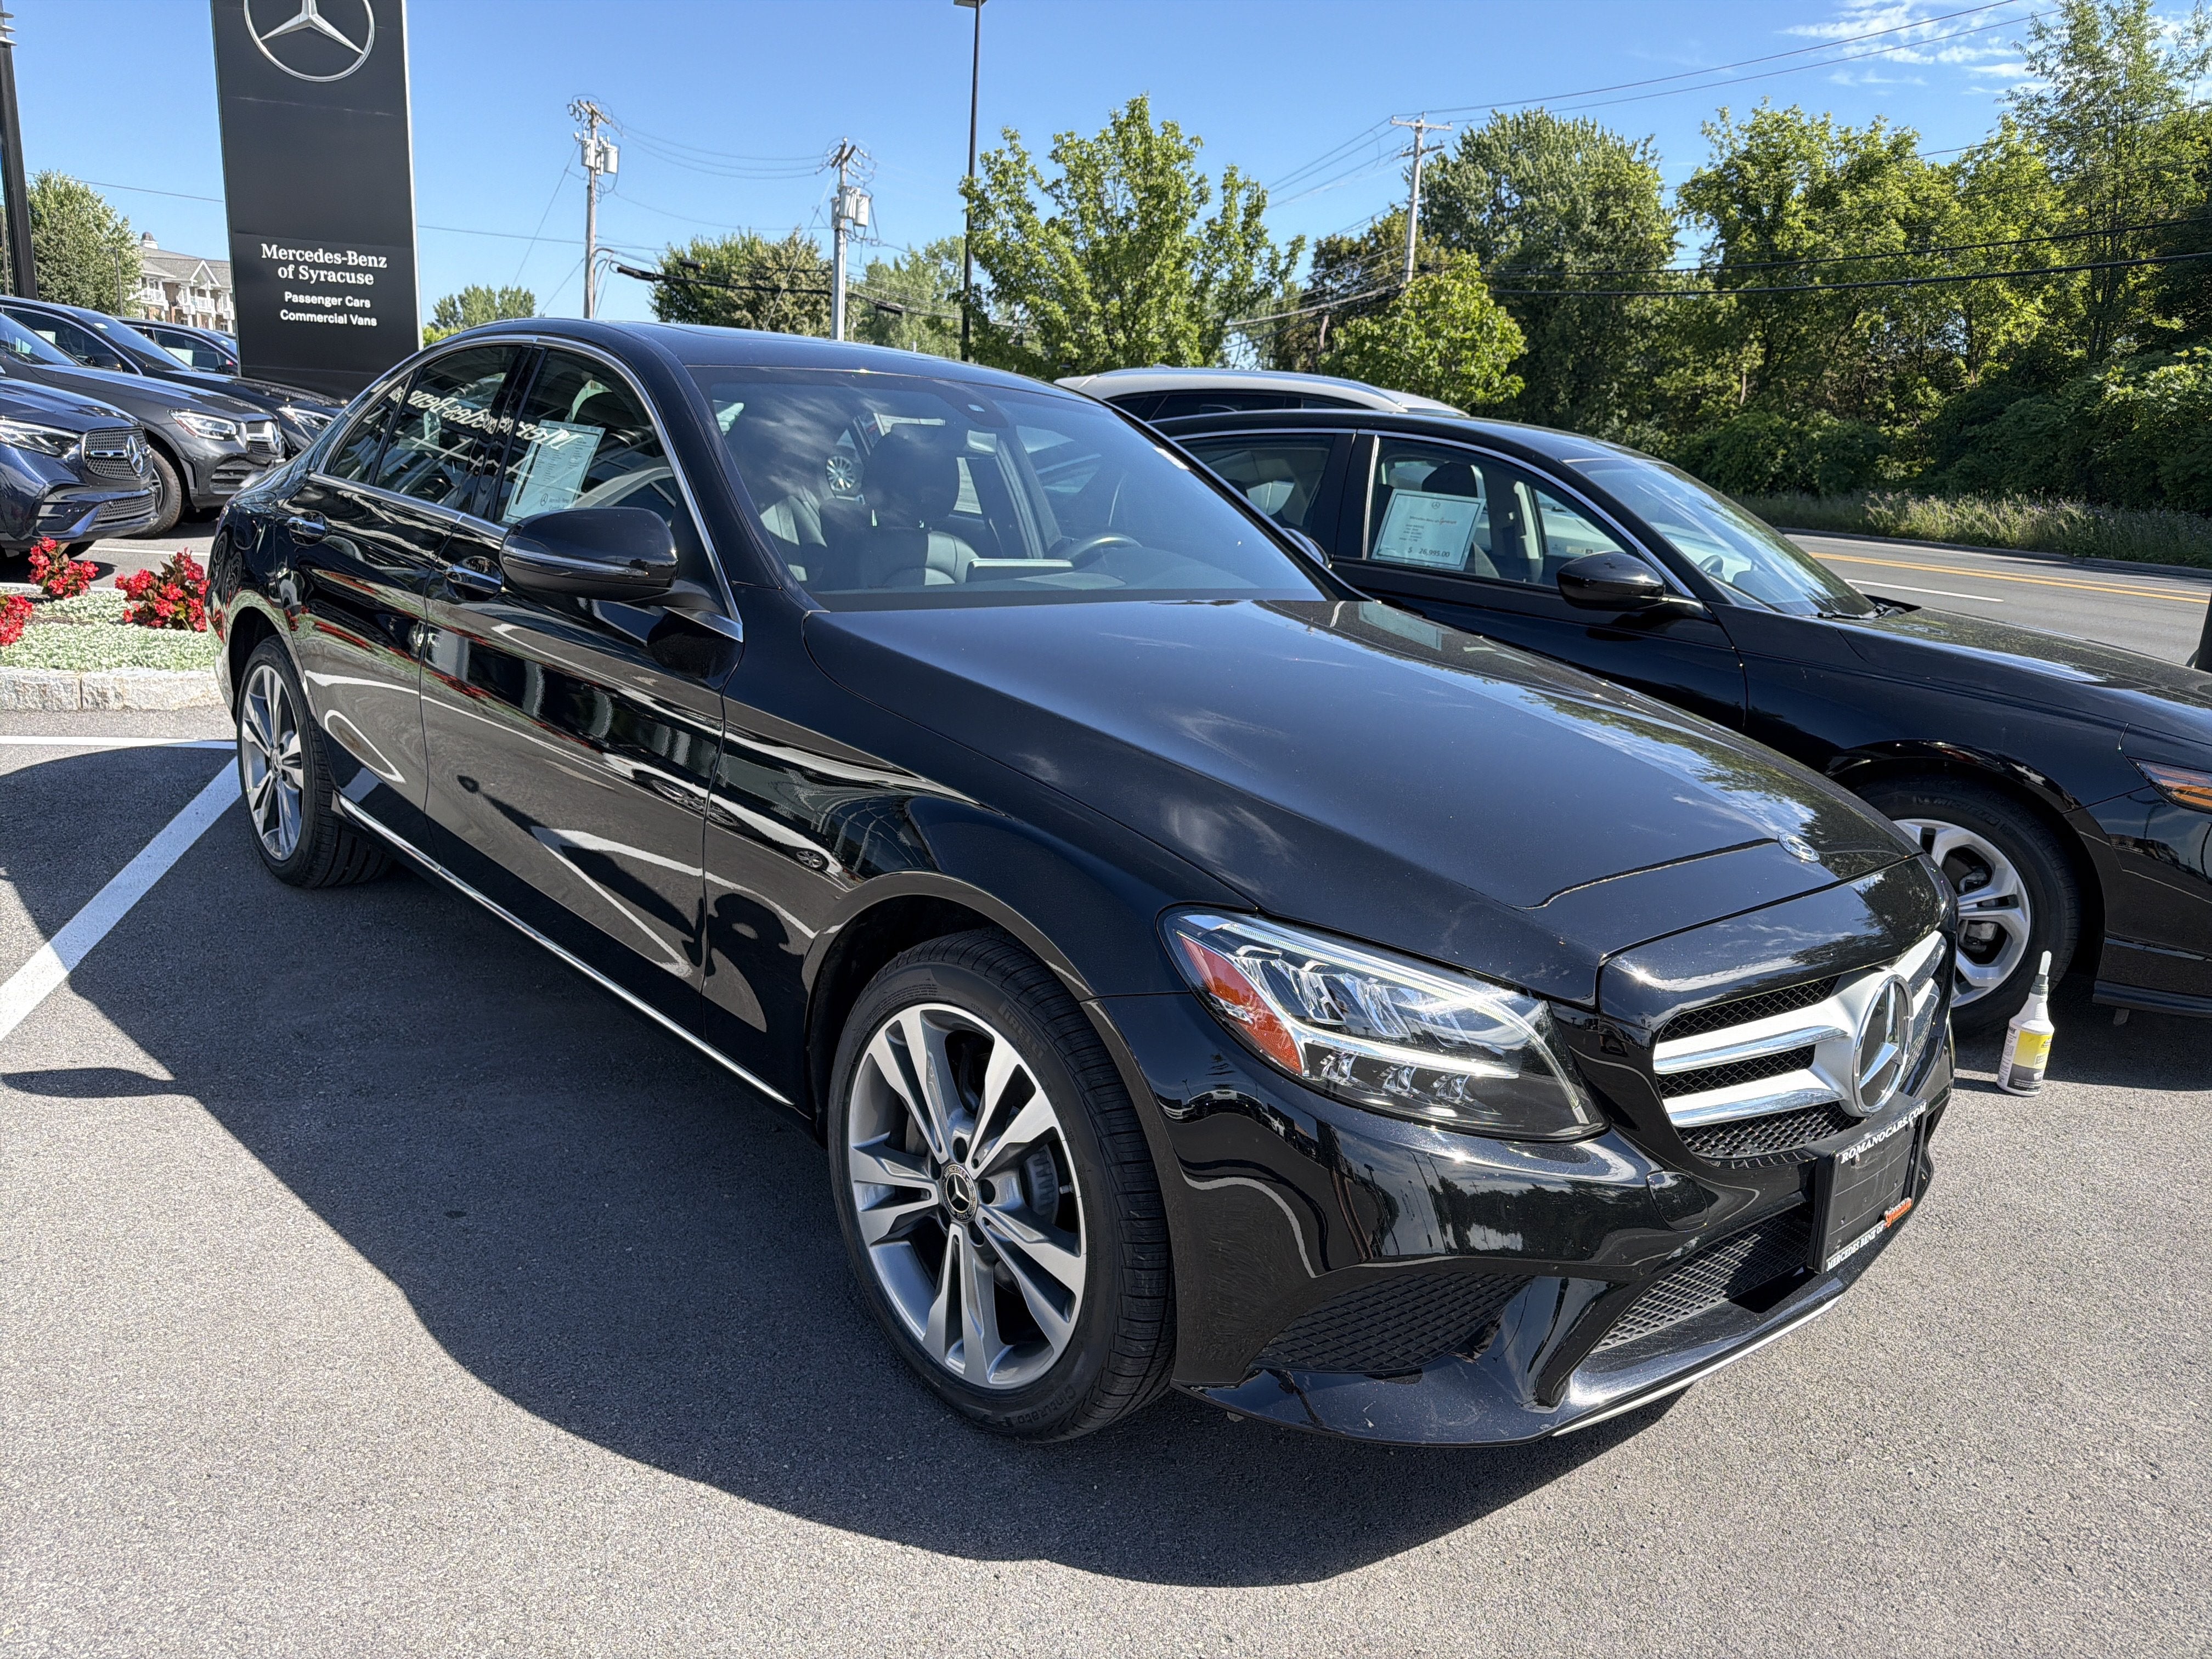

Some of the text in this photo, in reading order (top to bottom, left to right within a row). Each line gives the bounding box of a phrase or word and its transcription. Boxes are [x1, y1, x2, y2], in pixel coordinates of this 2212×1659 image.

[261, 243, 387, 268] Mercedes-Benz
[278, 264, 374, 285] of Syracuse
[284, 291, 371, 308] Passenger Cars
[280, 309, 377, 326] Commercial Vans
[998, 998, 1049, 1059] PIRELLI
[1840, 1101, 1927, 1164] ROMANOCARS.COM
[944, 1166, 966, 1179] MERCEDES
[956, 1210, 969, 1220] BENZ
[1826, 1223, 1884, 1272] MERCEDES BENZ OF
[1017, 1384, 1076, 1424] Cinturato
